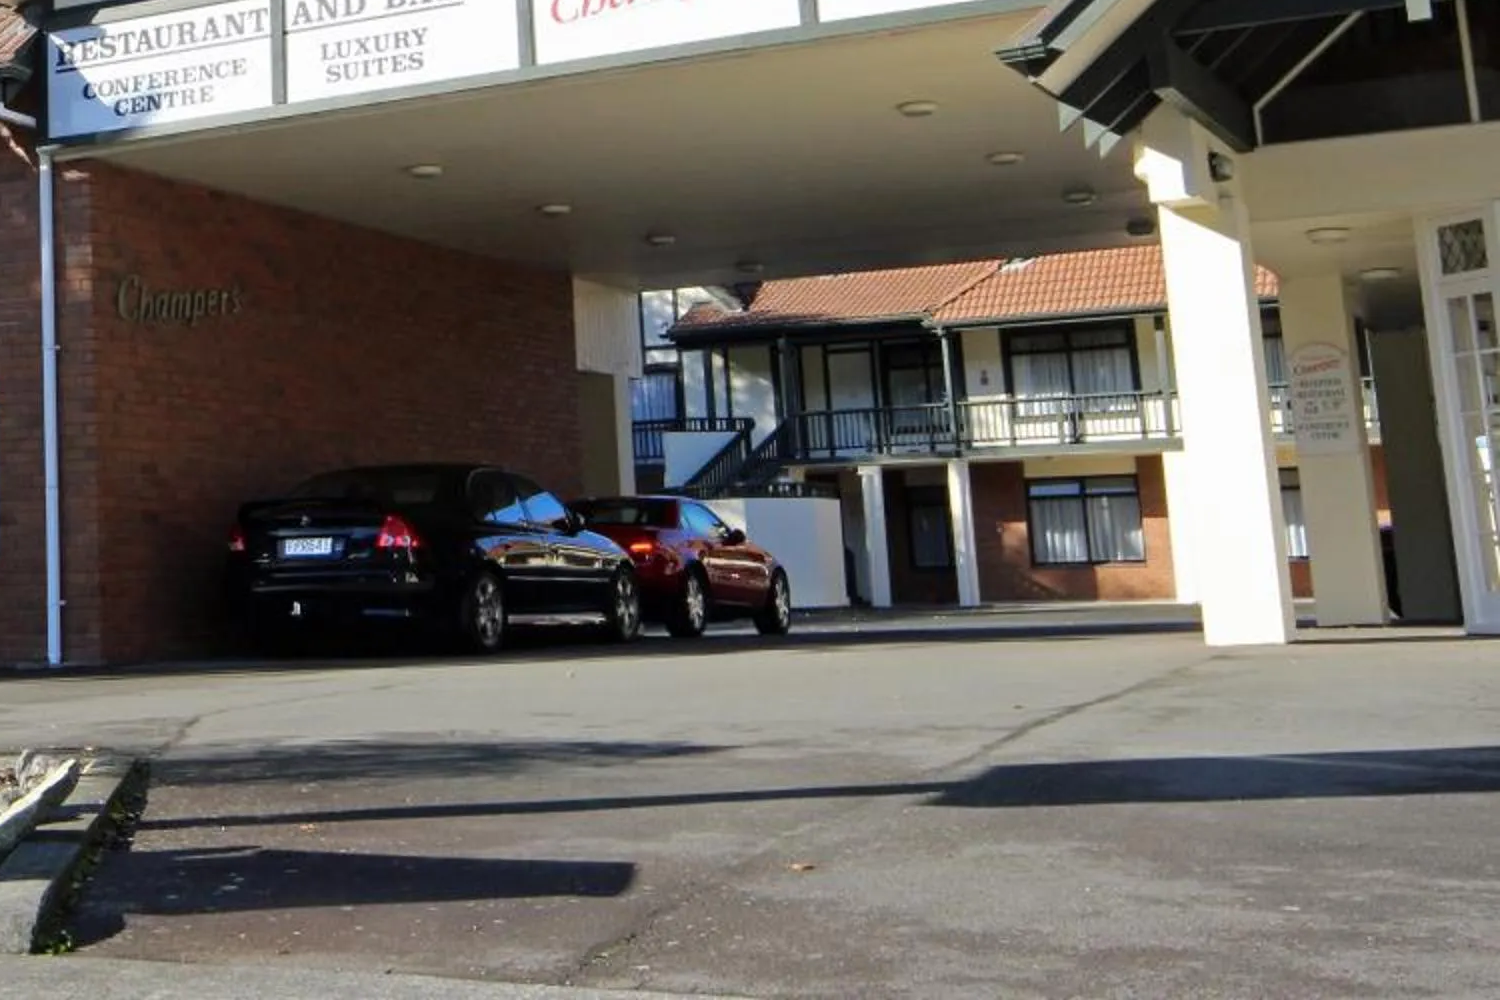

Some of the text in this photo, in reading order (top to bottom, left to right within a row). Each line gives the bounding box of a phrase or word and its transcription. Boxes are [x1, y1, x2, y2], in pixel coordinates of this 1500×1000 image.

[56, 7, 269, 66] RESTAURANT
[321, 27, 428, 62] LUXURY
[82, 58, 247, 100] CONFERENCE
[325, 51, 425, 84] SUITES
[113, 85, 214, 117] CENTRE
[118, 274, 244, 327] Champers
